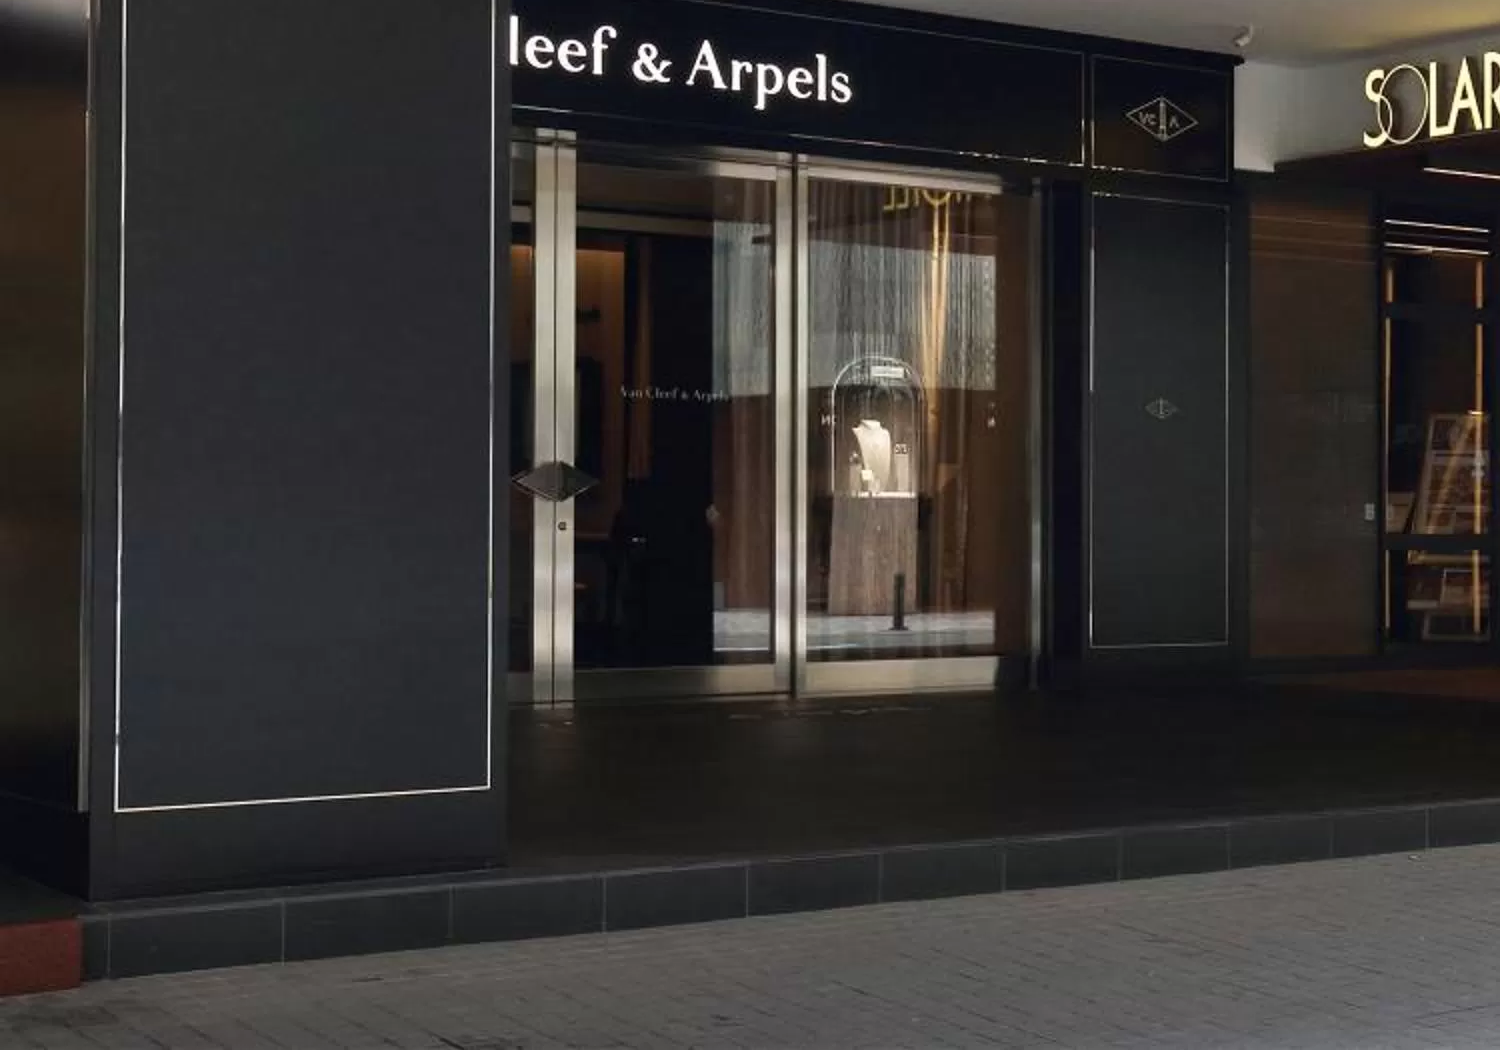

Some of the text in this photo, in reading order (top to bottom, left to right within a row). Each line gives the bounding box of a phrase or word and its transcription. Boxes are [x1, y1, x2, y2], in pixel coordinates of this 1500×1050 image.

[508, 14, 853, 111] leef & Arpels
